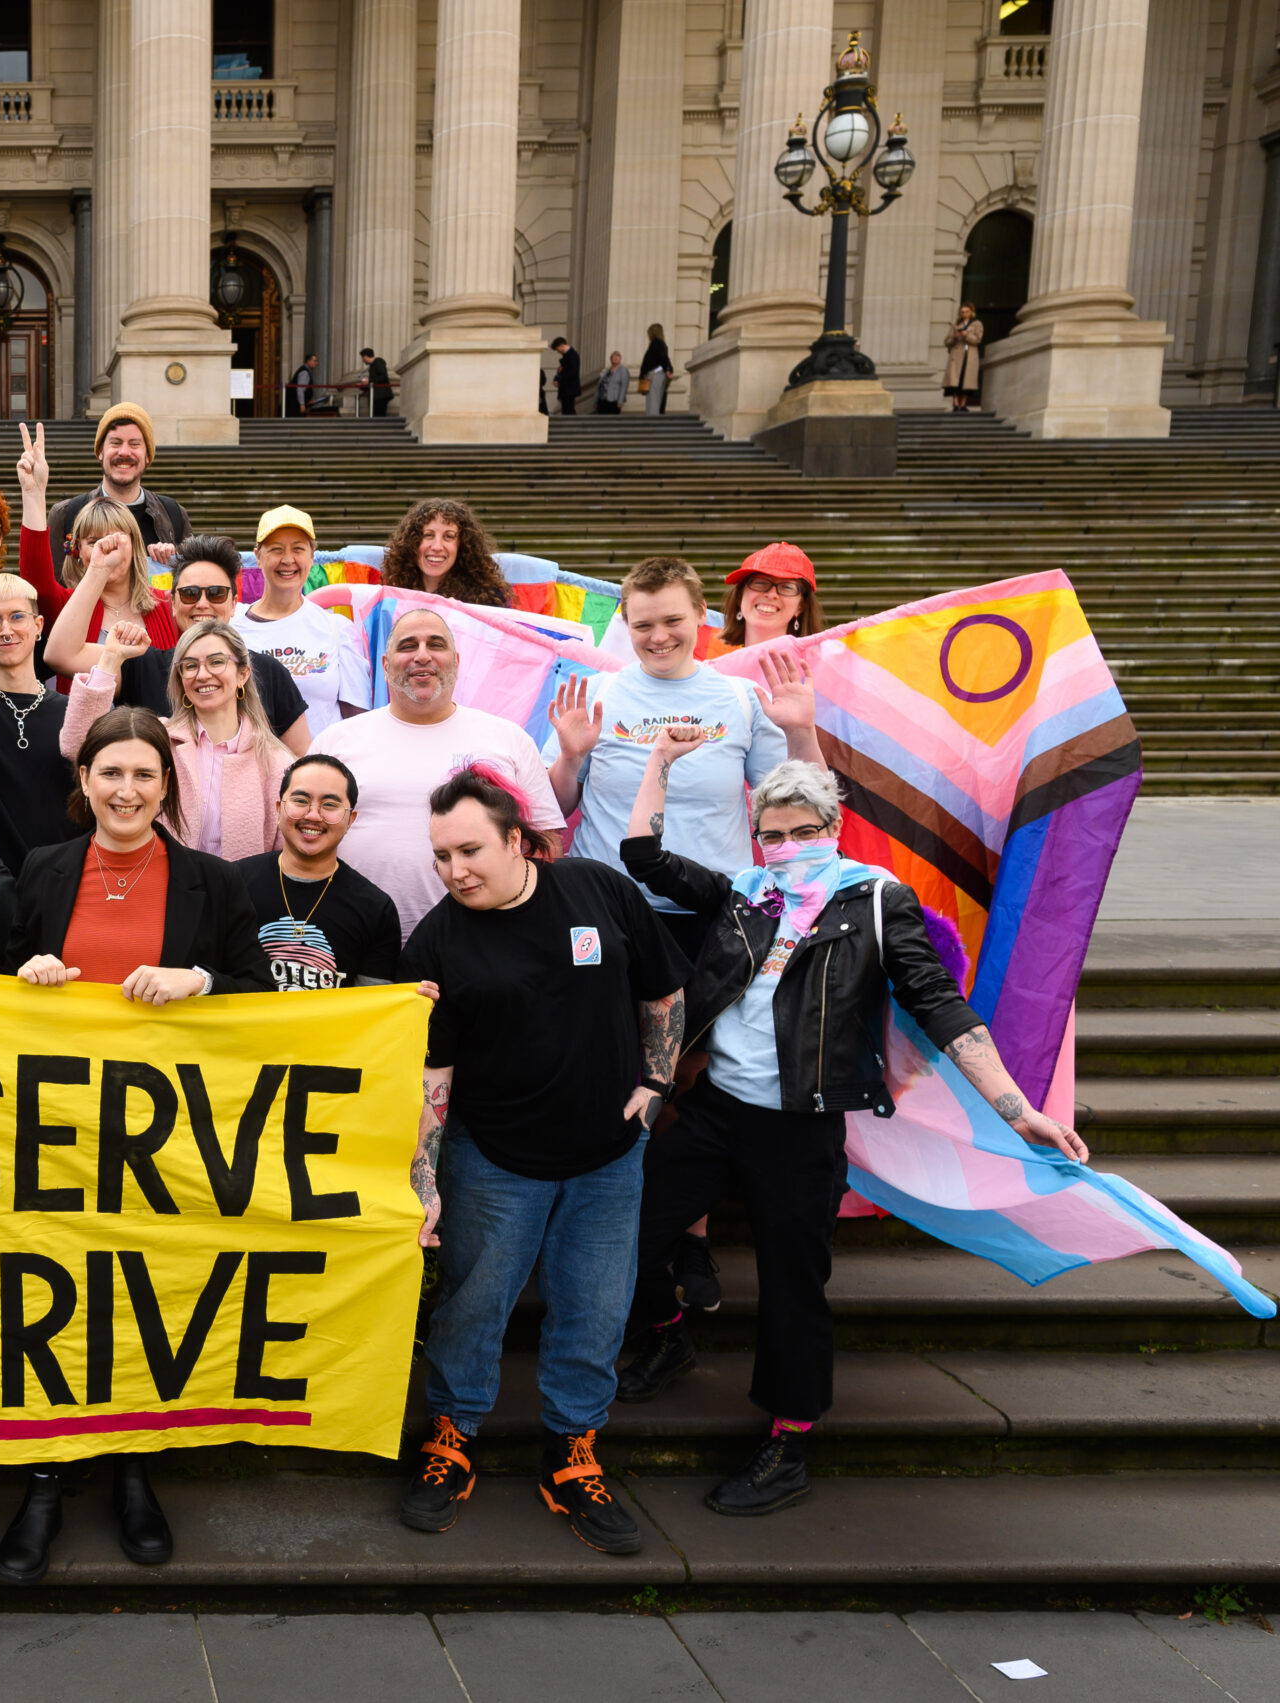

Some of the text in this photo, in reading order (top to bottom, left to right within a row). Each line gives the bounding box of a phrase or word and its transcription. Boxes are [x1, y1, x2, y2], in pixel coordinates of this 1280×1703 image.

[261, 646, 306, 657] INBOW
[643, 715, 703, 726] RAINBOW
[270, 959, 347, 989] OTECT
